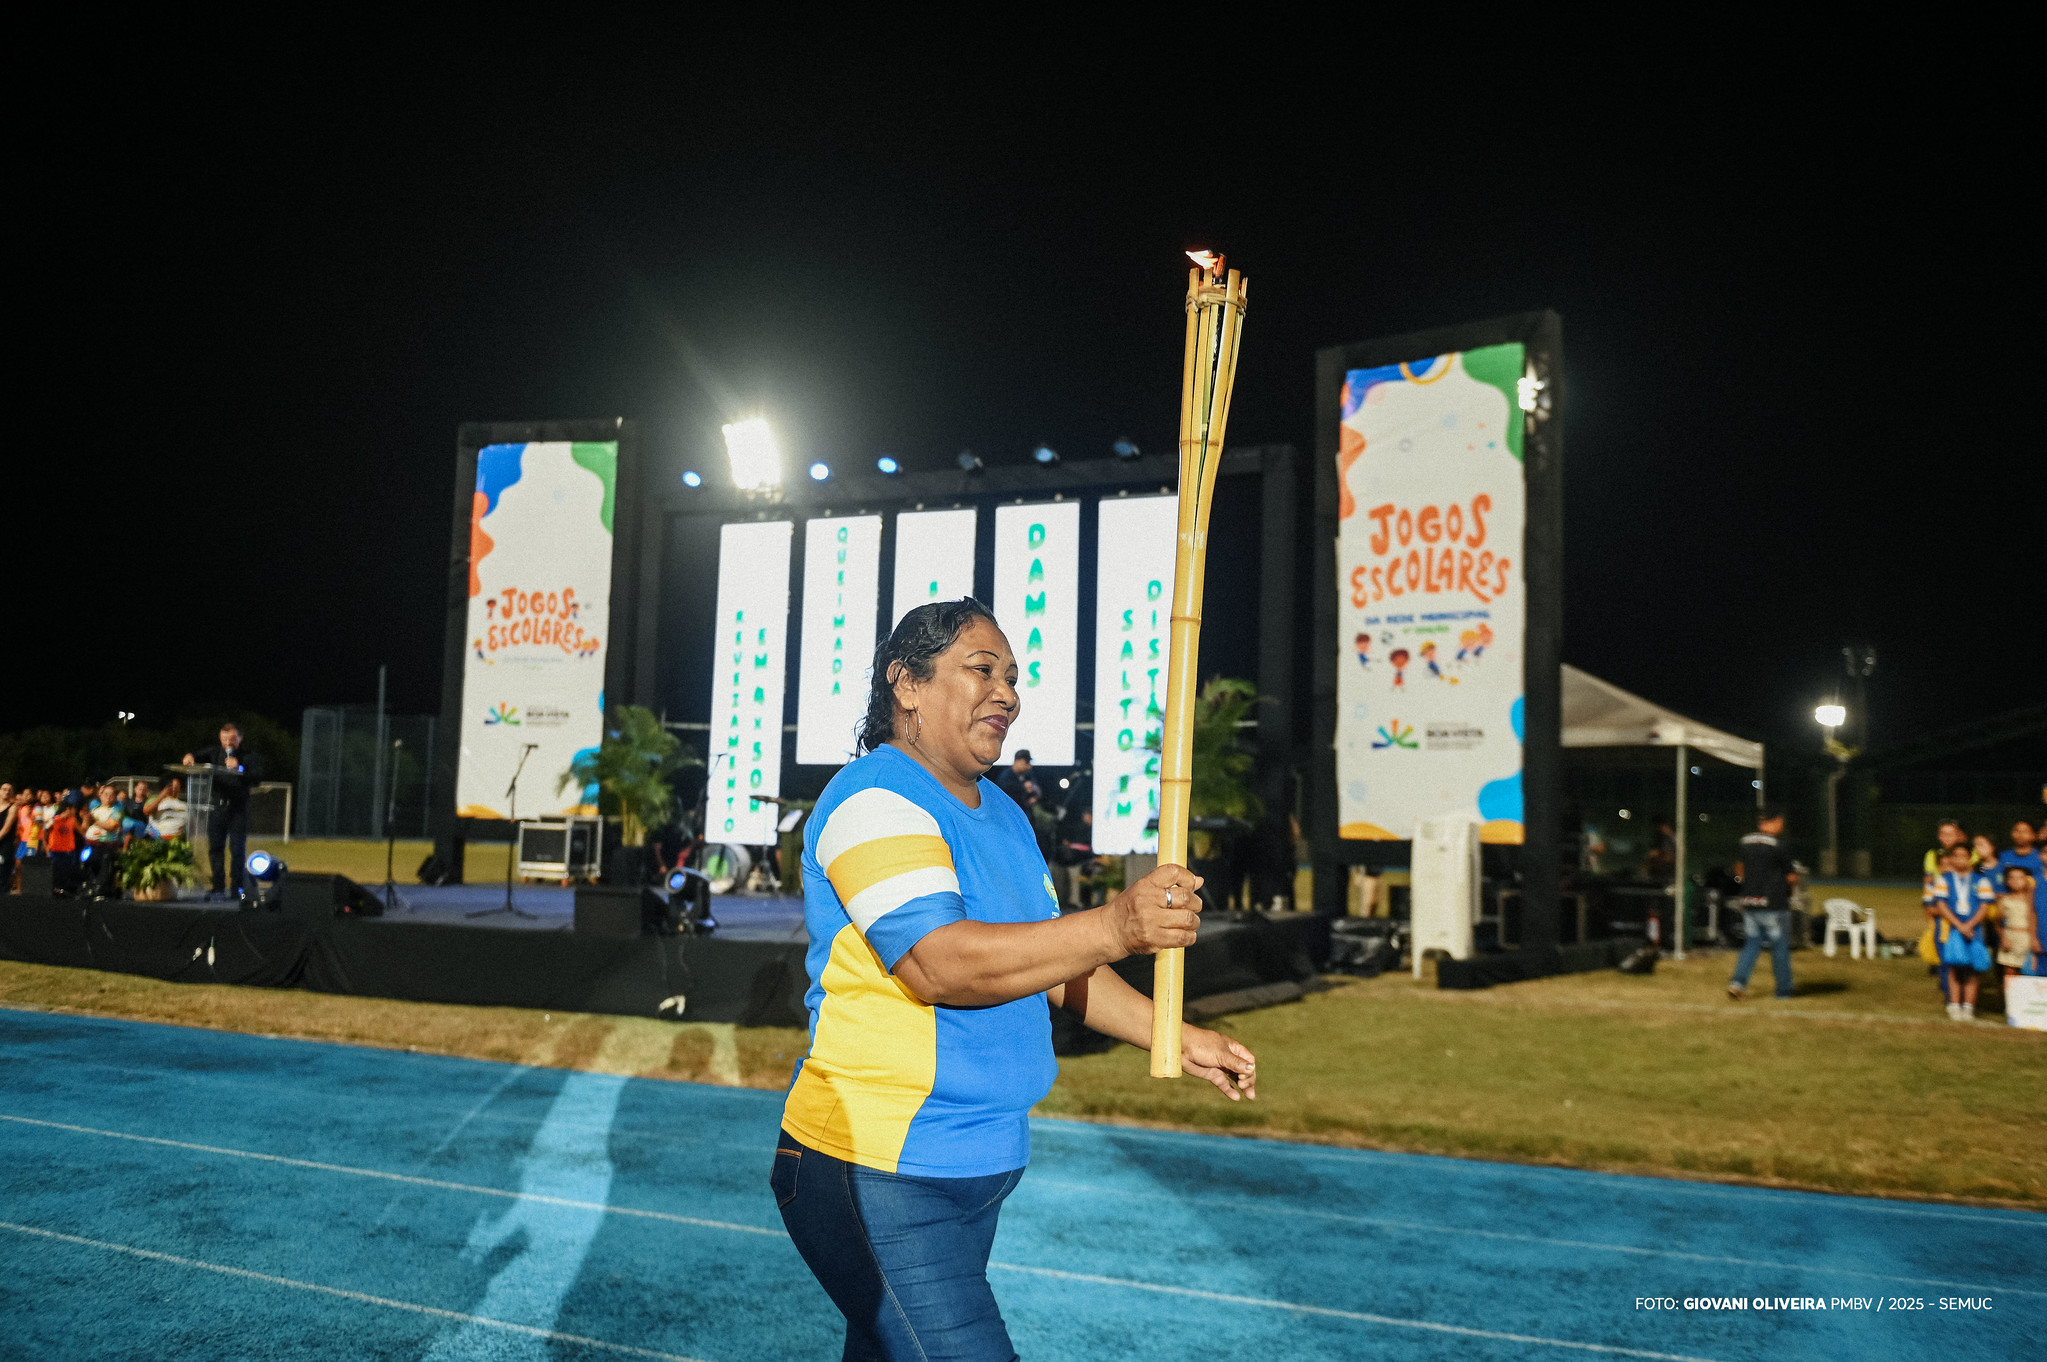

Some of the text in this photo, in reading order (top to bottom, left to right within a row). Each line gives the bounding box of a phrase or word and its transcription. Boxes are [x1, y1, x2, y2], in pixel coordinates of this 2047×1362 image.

[1368, 493, 1493, 557] JOGOS
[501, 587, 575, 619] JOGOS
[1024, 523, 1046, 688] DAMAS
[1350, 547, 1511, 610] ESCOLARES
[488, 617, 584, 654] ESCOLARES
[832, 526, 849, 696] QUEIMADA
[1117, 609, 1134, 752] SALTO
